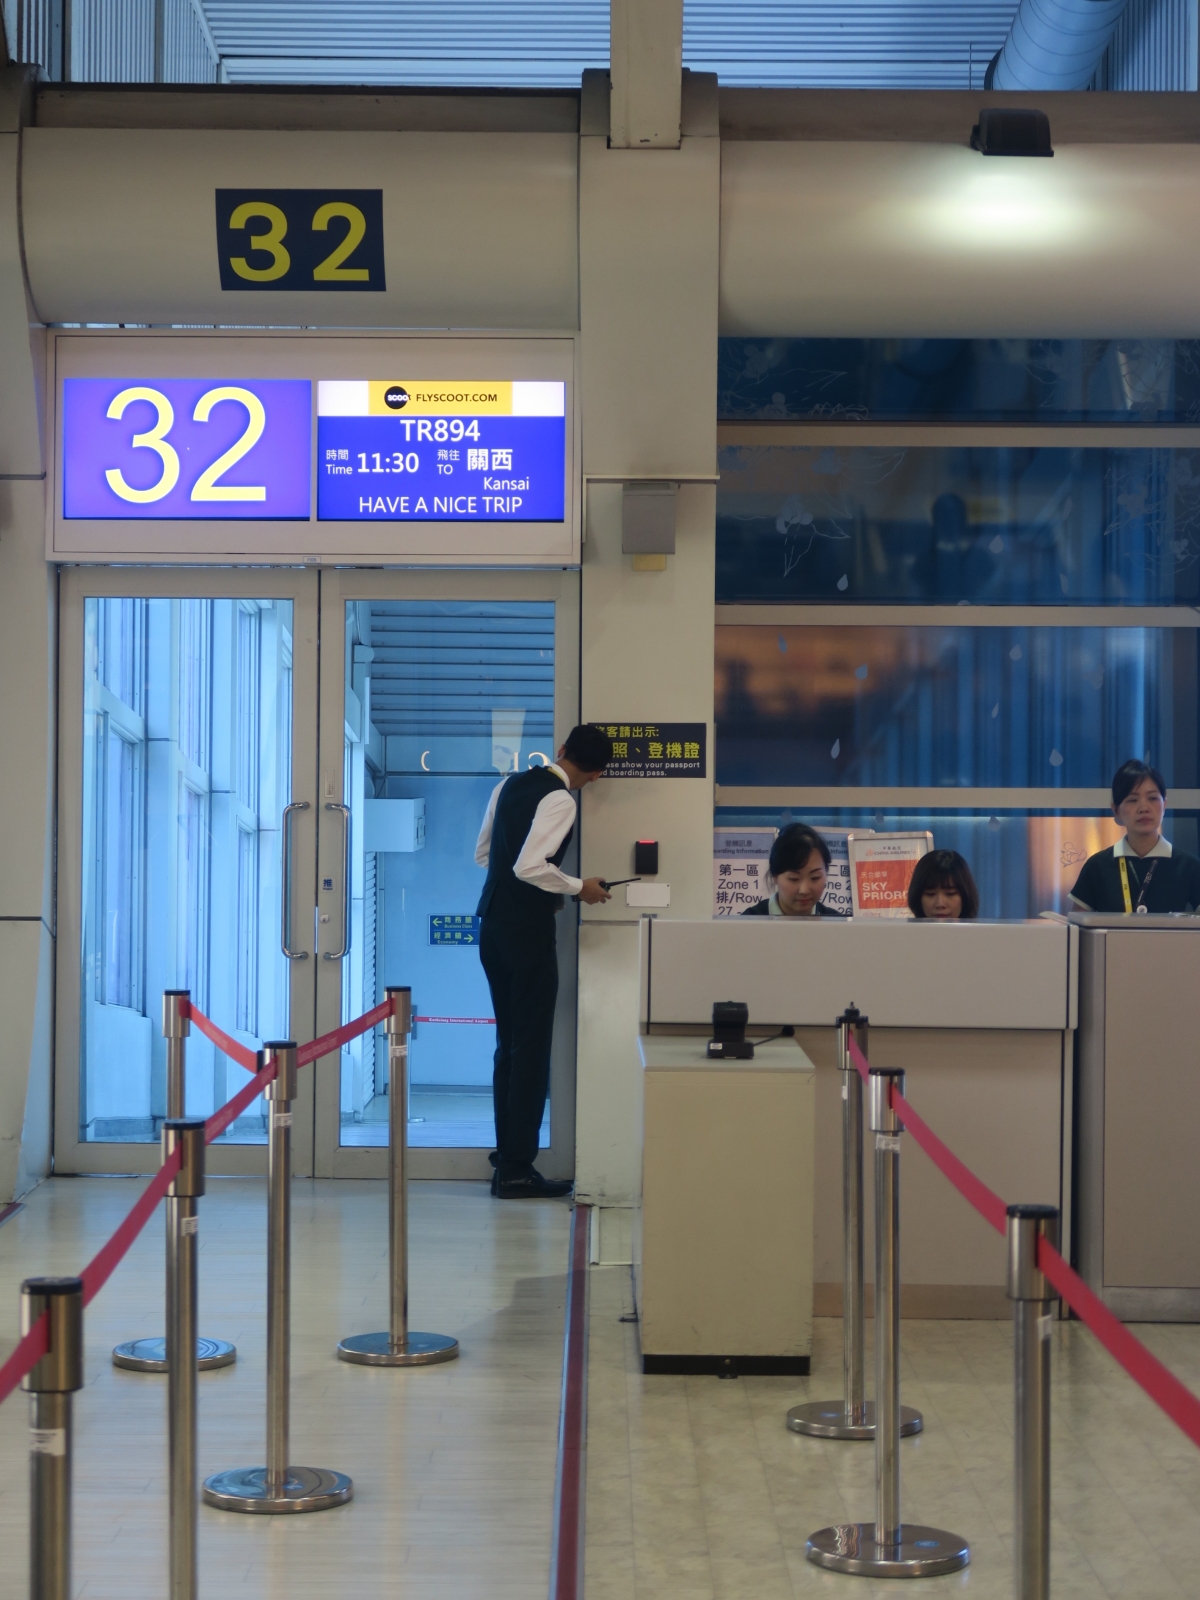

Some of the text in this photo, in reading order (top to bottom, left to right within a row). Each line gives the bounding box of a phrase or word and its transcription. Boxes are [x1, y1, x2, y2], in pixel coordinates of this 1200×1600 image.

[229, 201, 370, 282] 32
[416, 393, 498, 402] FLYSCOOT.COM
[400, 419, 480, 442] TR894
[105, 386, 266, 503] 32
[326, 449, 349, 461] 時間
[437, 449, 460, 461] 飛往
[467, 448, 513, 471] 關西
[357, 452, 420, 473] 11:30
[326, 464, 353, 475] Time
[437, 464, 453, 475] TO
[483, 476, 530, 490] Kansai
[359, 497, 522, 513] HAVE A NICE TRIP
[612, 742, 700, 759] 照、登機證
[609, 769, 644, 777] boarding
[719, 863, 759, 876] 第一區
[827, 864, 850, 877] 二區
[718, 879, 759, 890] Zone 1
[862, 882, 888, 891] SKY
[716, 891, 763, 904] 排/Row
